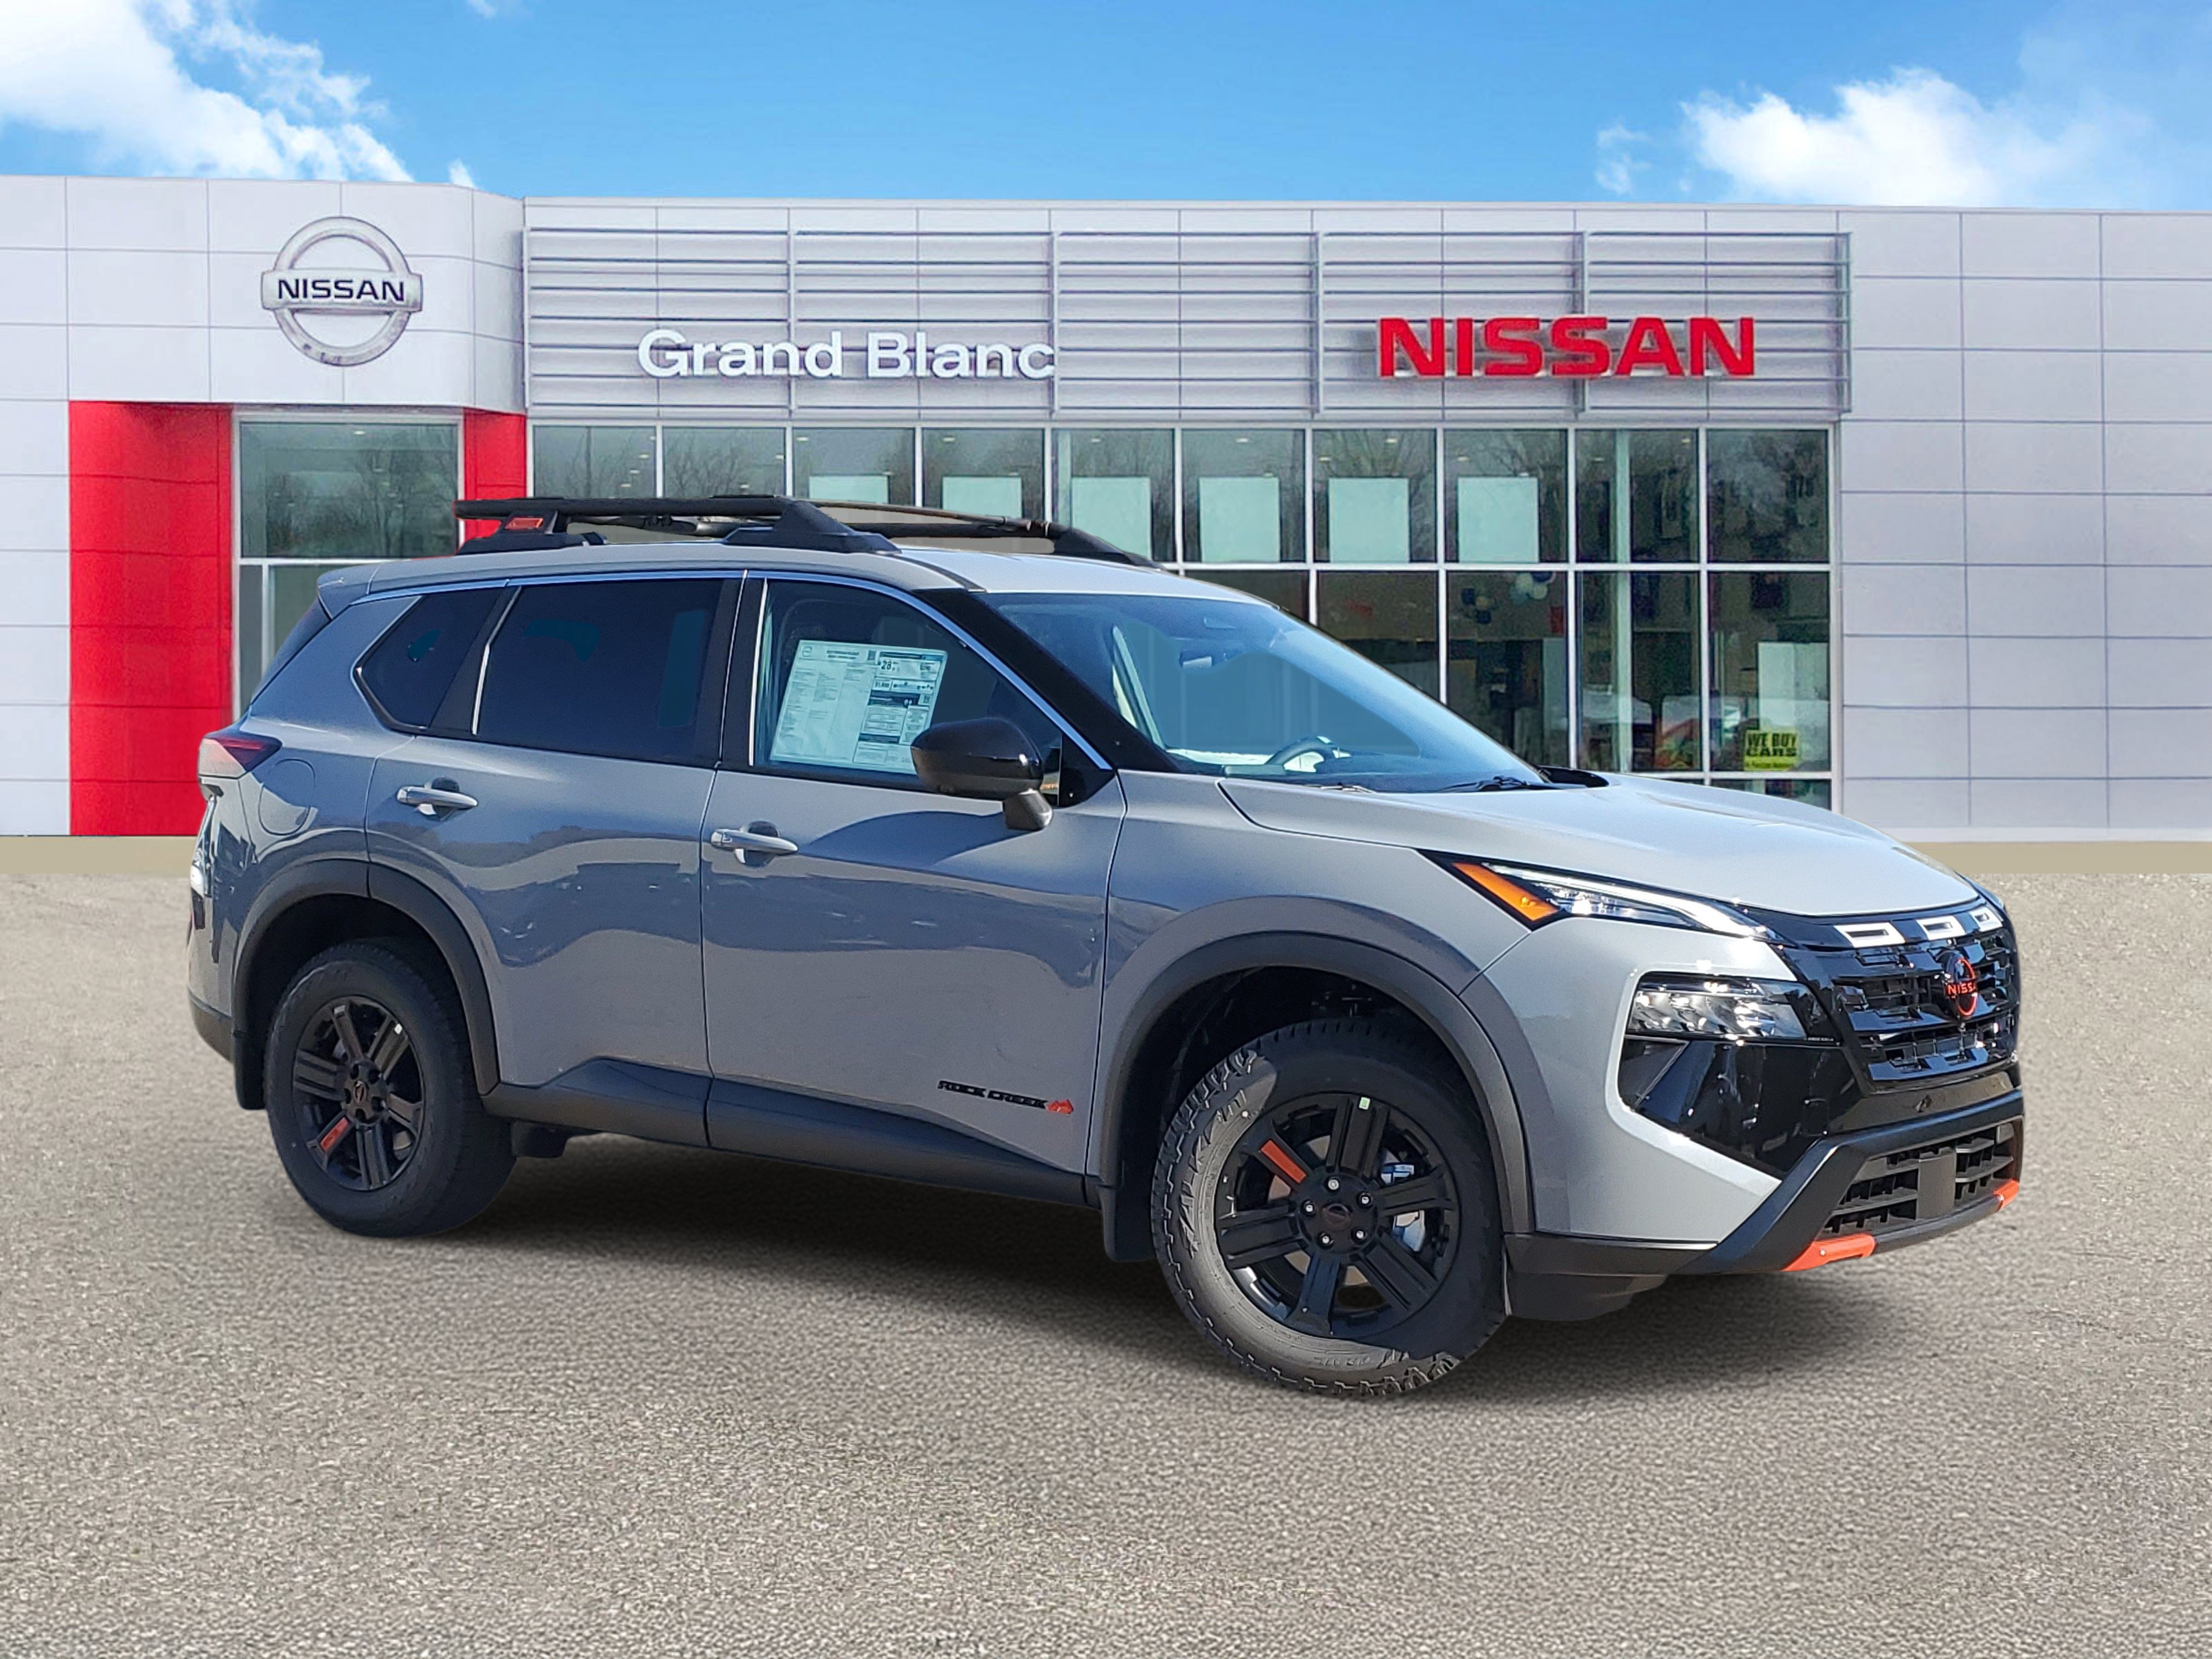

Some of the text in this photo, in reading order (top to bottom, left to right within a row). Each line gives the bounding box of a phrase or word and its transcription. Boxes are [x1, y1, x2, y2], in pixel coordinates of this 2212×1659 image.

[279, 279, 404, 302] NISSAN
[638, 329, 1056, 379] Grand Blanc
[1379, 317, 1755, 376] NISSAN
[1747, 747, 1797, 757] CARS
[1748, 733, 1796, 747] WE BUY
[938, 1080, 1049, 1109] ROCK CREEK
